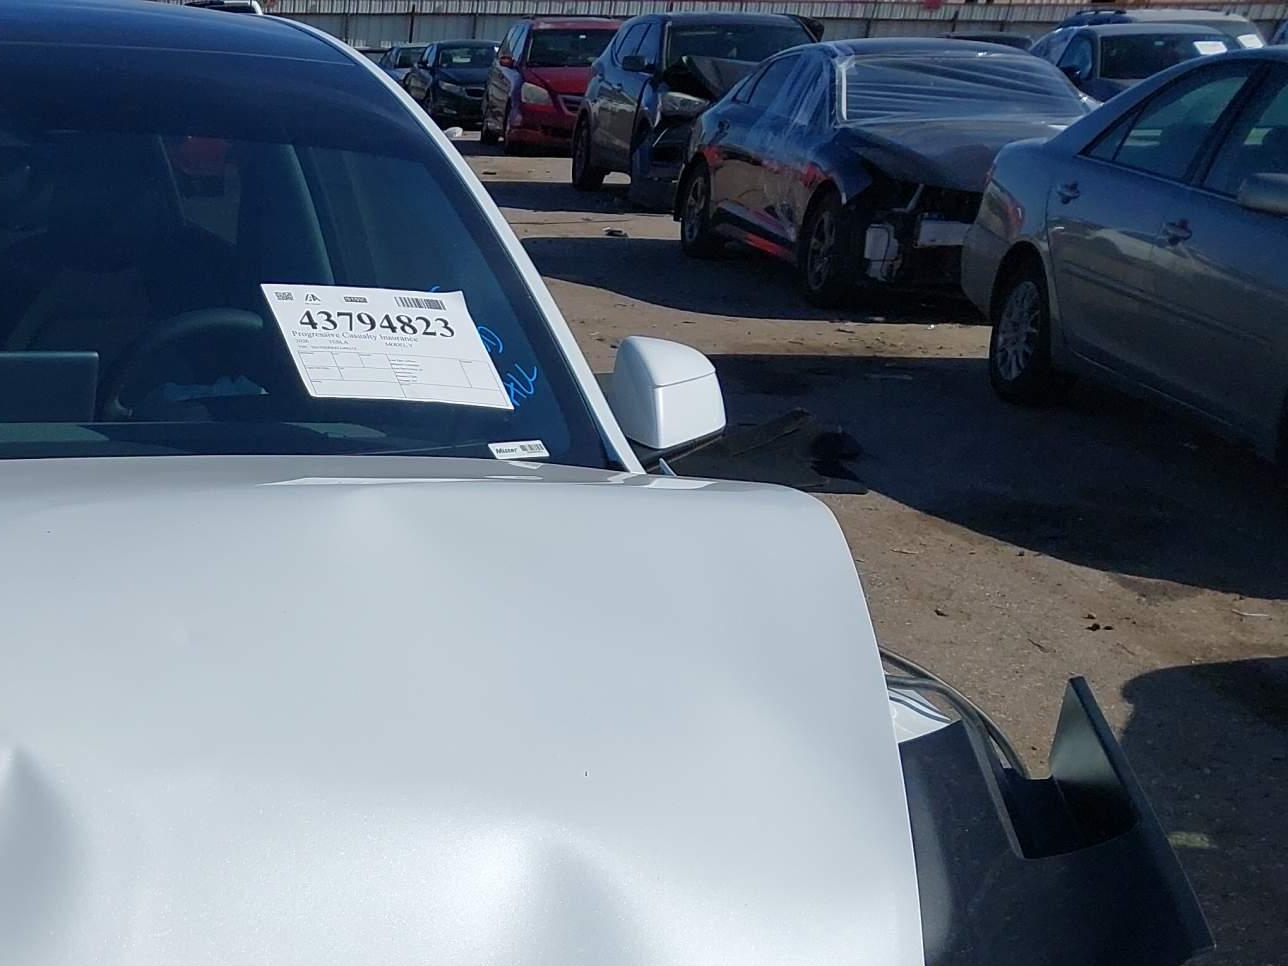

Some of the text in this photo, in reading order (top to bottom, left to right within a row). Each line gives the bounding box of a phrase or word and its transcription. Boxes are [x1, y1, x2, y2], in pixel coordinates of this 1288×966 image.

[299, 310, 455, 338] 43794823
[291, 331, 419, 343] Progressive Casualty Insurance
